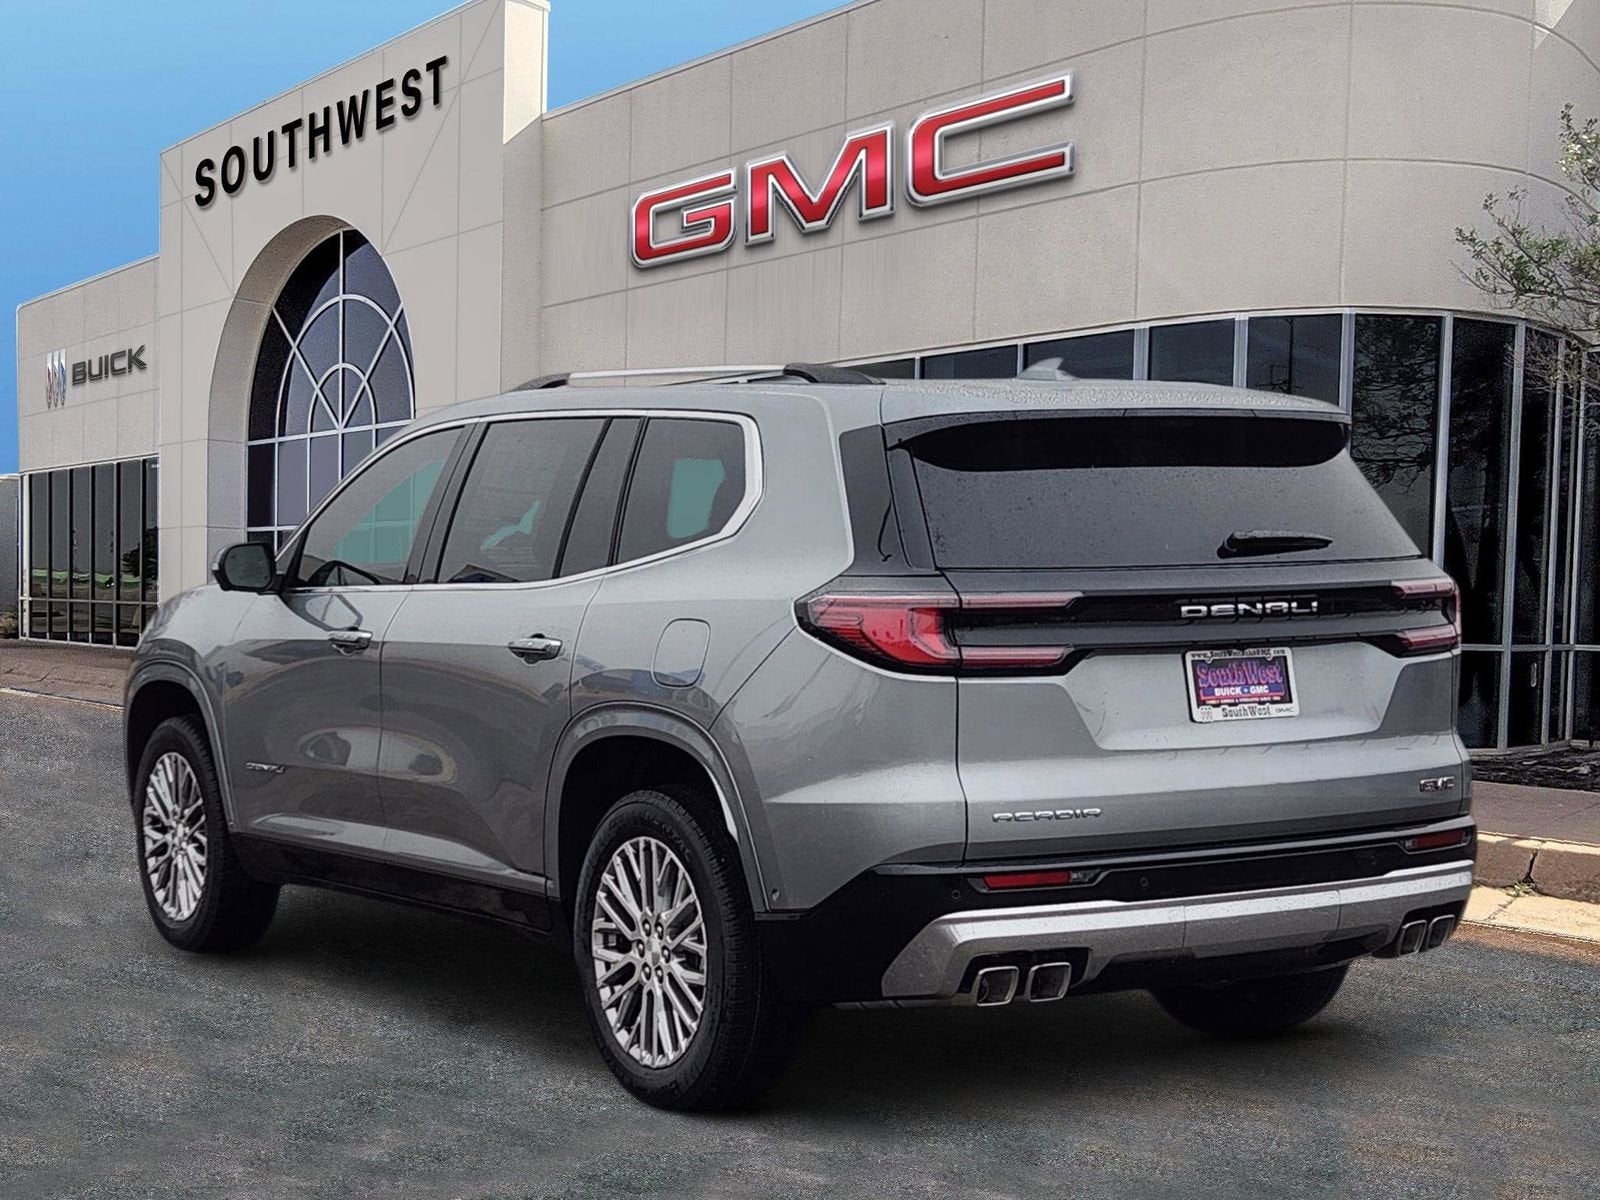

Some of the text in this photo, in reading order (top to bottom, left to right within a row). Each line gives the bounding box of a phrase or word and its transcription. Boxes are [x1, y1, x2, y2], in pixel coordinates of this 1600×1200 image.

[194, 55, 448, 207] SOUTHWEST
[630, 69, 1075, 268] GMC
[72, 344, 147, 385] BUICK
[1180, 601, 1318, 617] DENALI
[1196, 660, 1284, 687] SouthWest
[1214, 685, 1270, 696] BUICK GMC
[1221, 705, 1271, 718] SouthWest
[992, 808, 1102, 822] ACADIA
